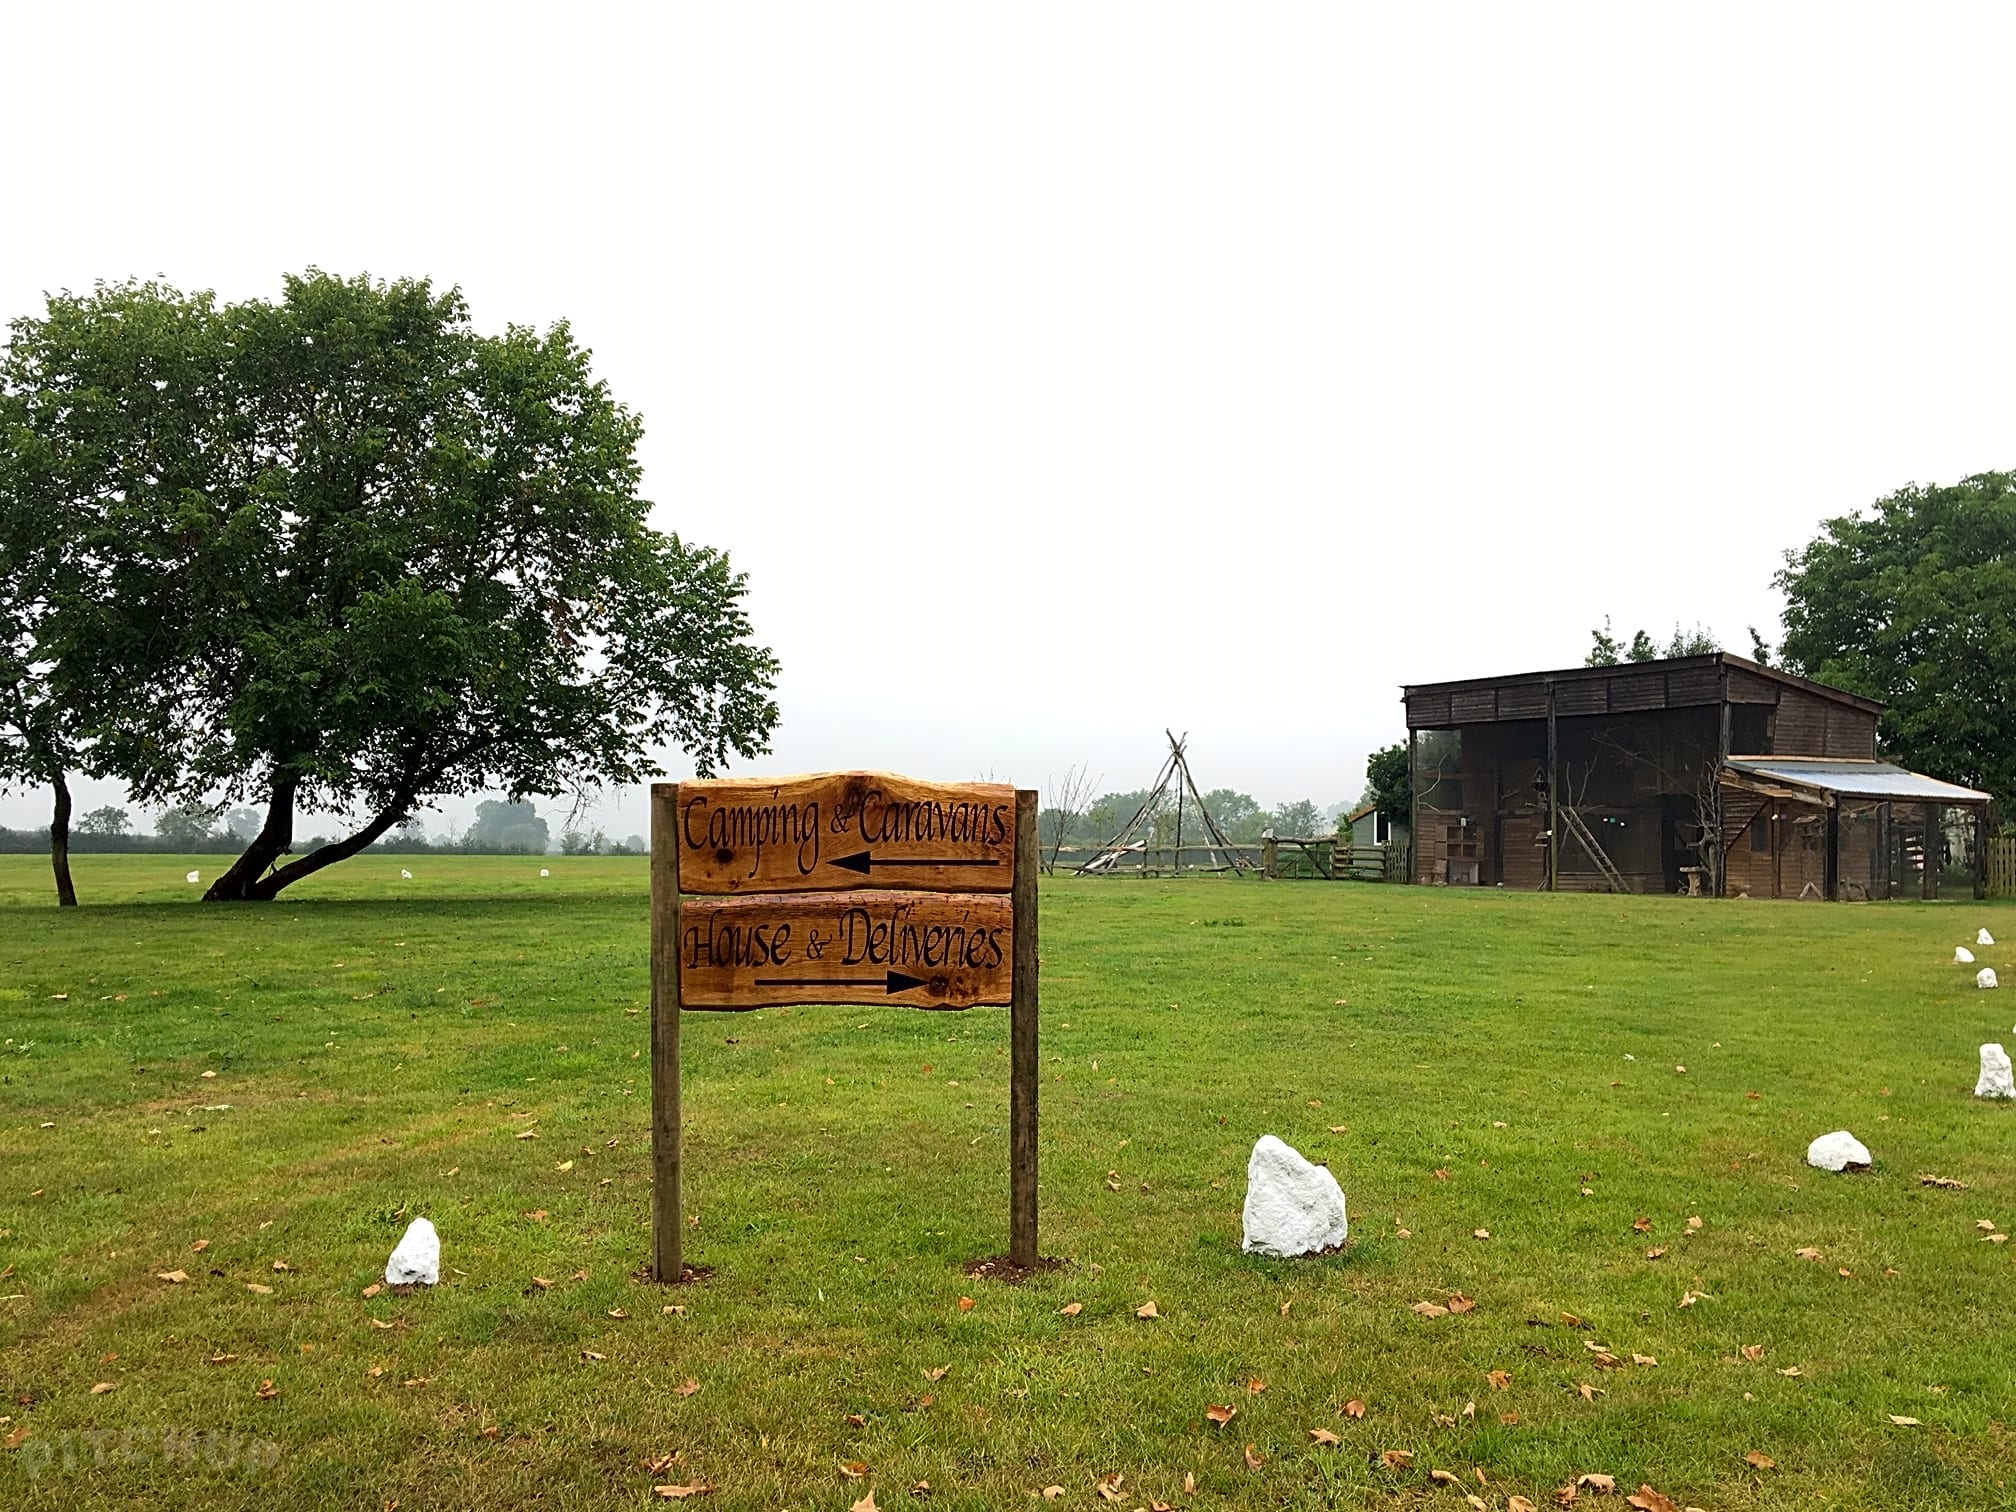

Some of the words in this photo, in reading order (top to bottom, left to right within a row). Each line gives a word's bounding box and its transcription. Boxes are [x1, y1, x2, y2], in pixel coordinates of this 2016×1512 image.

[684, 787, 819, 878] Camping
[831, 803, 853, 834] &
[859, 790, 1008, 846] Caravans
[684, 908, 791, 969] House
[806, 929, 833, 960] &
[839, 904, 1003, 969] Deliveries
